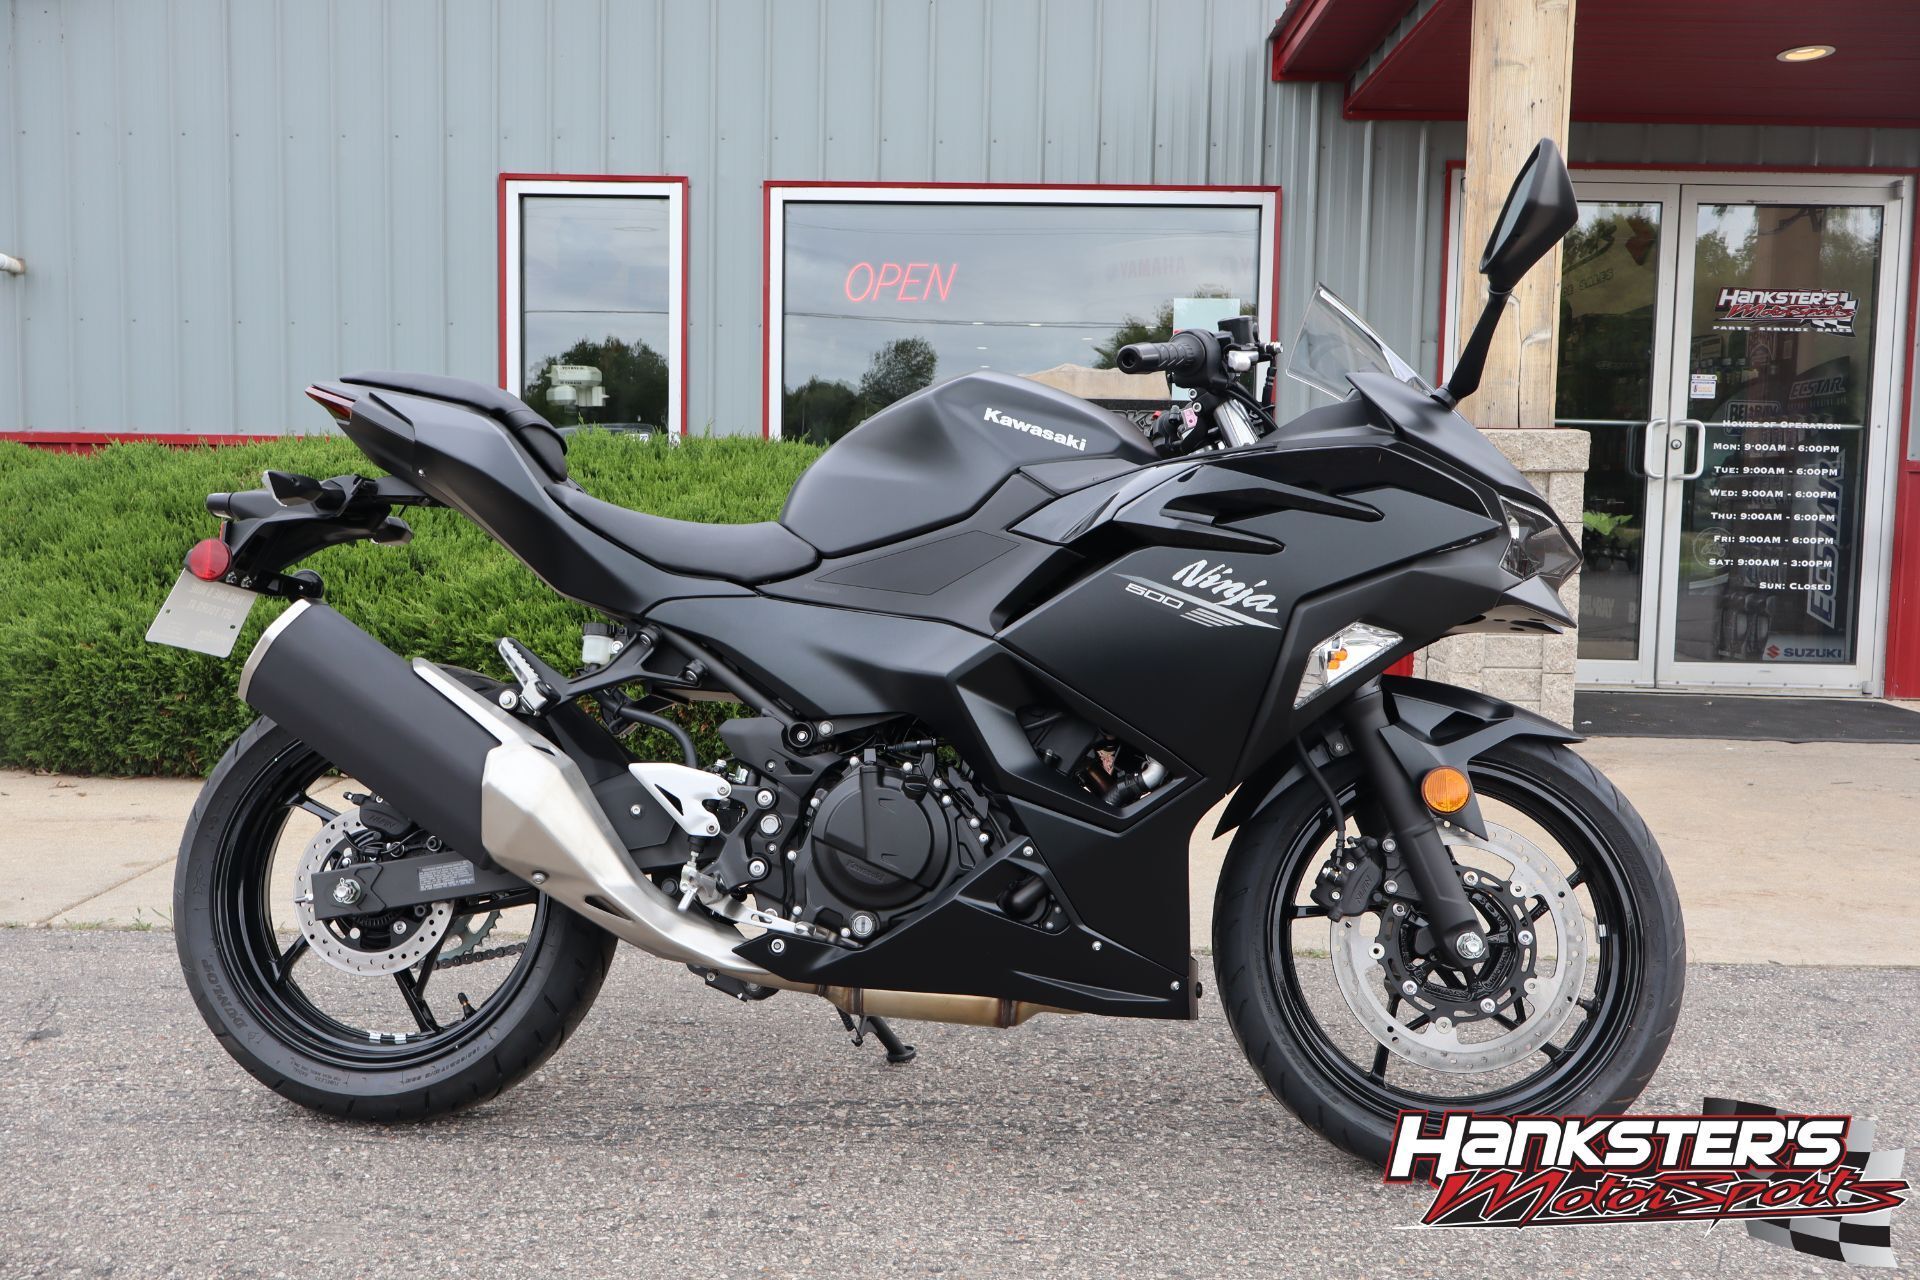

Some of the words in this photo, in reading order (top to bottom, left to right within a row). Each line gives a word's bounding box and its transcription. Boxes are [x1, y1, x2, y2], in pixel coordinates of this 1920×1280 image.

[844, 262, 959, 303] OPEN
[1789, 376, 1846, 400] ECSTAR
[983, 407, 1087, 452] Kawasaki
[1722, 419, 1761, 428] HOURS
[1763, 420, 1778, 429] OF
[1780, 421, 1841, 430] OPERATION
[1713, 442, 1741, 451] MON:
[1797, 444, 1840, 453] 6:00PM
[1713, 465, 1739, 474] TUE:
[1742, 466, 1785, 475] 9:00AM
[1796, 467, 1838, 477] 6:00PM
[1709, 488, 1738, 497] WED:
[1741, 489, 1784, 498] 9:00AM
[1794, 490, 1837, 499] 6:00PM
[1710, 511, 1737, 520] THU:
[1740, 512, 1783, 521] 9:00AM
[1793, 513, 1836, 522] 6:00PM
[1713, 534, 1735, 543] FRI:
[1738, 535, 1781, 544] 9:00AM
[1792, 536, 1834, 545] 6:00PM
[1708, 557, 1734, 566] SAT:
[1737, 558, 1780, 567] 9:00AM
[1790, 559, 1833, 568] 3:00PM
[1171, 559, 1279, 614] Ninja
[1759, 581, 1786, 590] SUN:
[1789, 582, 1832, 591] CLOSED
[1124, 582, 1185, 610] 500
[1783, 647, 1842, 659] SUZUKI
[201, 957, 249, 1032] DUNLOP
